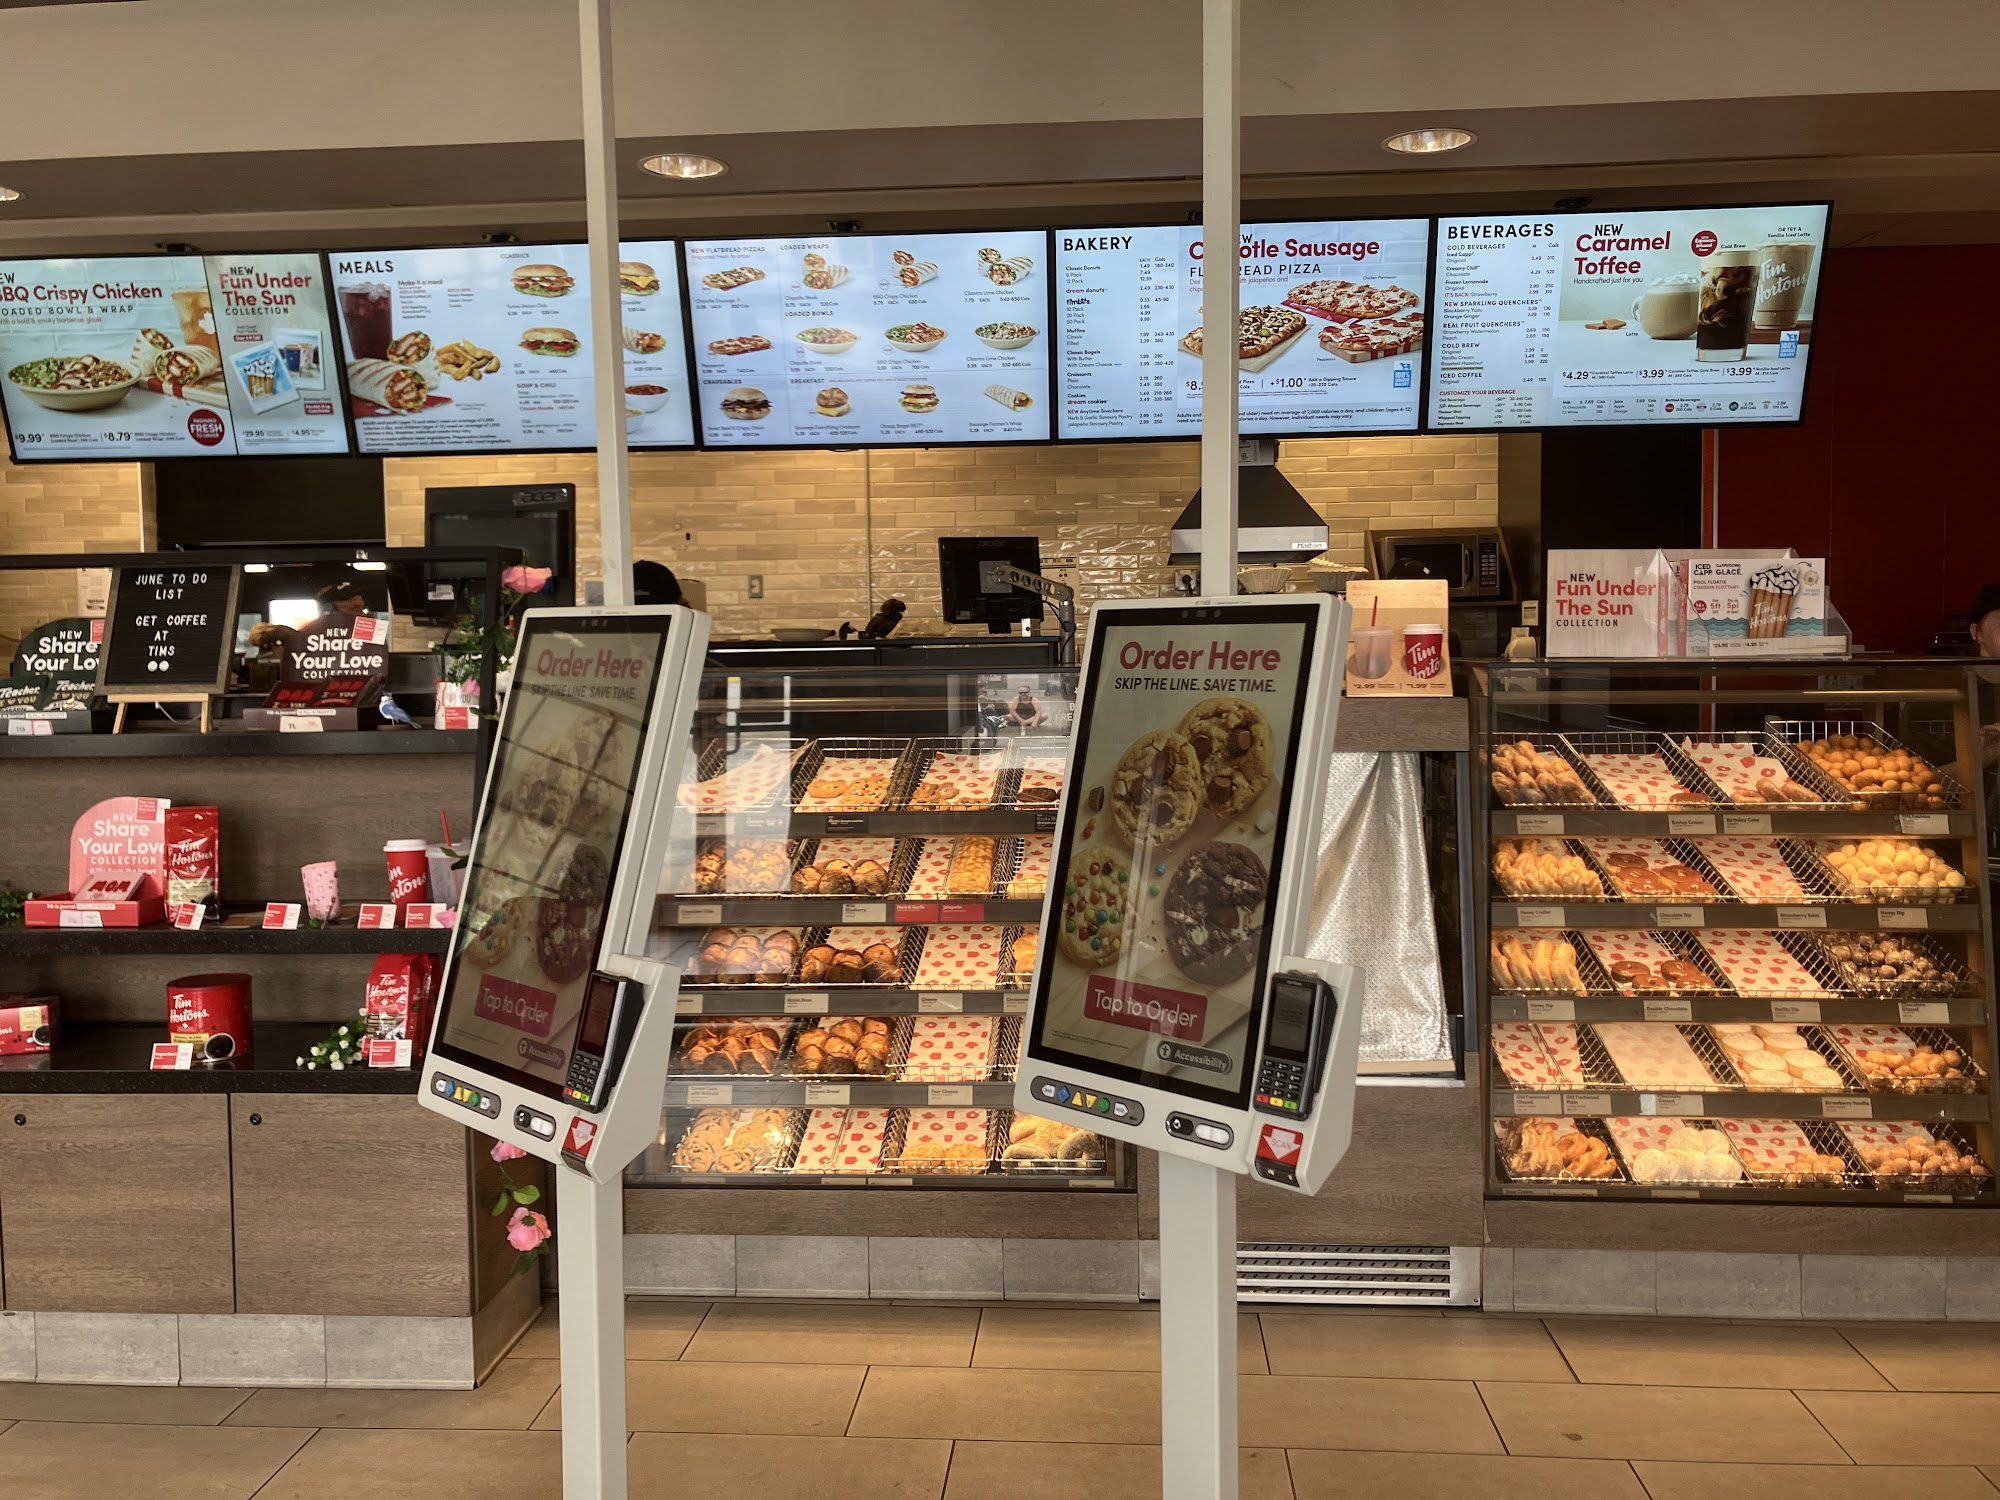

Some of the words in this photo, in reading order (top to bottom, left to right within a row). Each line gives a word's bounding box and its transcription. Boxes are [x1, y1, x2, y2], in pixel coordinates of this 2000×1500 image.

[1448, 224, 1554, 239] BEVERAGES
[1595, 224, 1623, 237] NEW
[1064, 236, 1132, 251] BAKERY
[1576, 231, 1671, 252] Caramel
[1189, 239, 1279, 260] Cotle
[1285, 238, 1380, 261] Sausage
[230, 266, 253, 275] NEW
[339, 260, 394, 274] MEALS
[1279, 264, 1321, 274] PIZZA
[1574, 256, 1641, 275] Toffee
[1760, 258, 1786, 282] Tim
[219, 274, 252, 289] Fun
[256, 272, 312, 288] Under
[1573, 277, 1610, 285] Handcrafted
[1611, 277, 1621, 285] just
[0, 286, 29, 303] BQ
[34, 285, 88, 304] Crispy
[93, 283, 162, 299] Chicken
[1757, 273, 1807, 306] Hortons
[222, 291, 256, 306] The
[261, 290, 296, 305] Sun
[1, 308, 42, 316] OADED
[49, 306, 81, 314] BOWL
[88, 306, 93, 314] &
[101, 305, 134, 313] WRAP
[225, 307, 289, 315] COLLECTION
[191, 424, 223, 433] FRESH
[135, 574, 164, 585] JUNE
[172, 573, 186, 584] TO
[192, 573, 208, 584] DO
[1570, 573, 1596, 582] NEW
[156, 589, 183, 600] LIST
[1557, 579, 1593, 596] Fun
[1596, 579, 1656, 596] Under
[1556, 599, 1591, 616] The
[1597, 599, 1633, 615] Sun
[135, 615, 158, 626] GET
[167, 614, 207, 626] COFFEE
[1556, 618, 1618, 627] COLLECTION
[59, 631, 82, 640] NEW
[154, 631, 168, 641] AT
[326, 628, 348, 636] NEW
[38, 637, 98, 654] Share
[307, 634, 363, 651] Share
[148, 645, 175, 657] TIMS
[1120, 640, 1203, 670] Order
[1208, 641, 1281, 671] Here
[1407, 642, 1436, 664] Tim
[22, 654, 68, 671] Your
[291, 652, 336, 669] Your
[340, 652, 383, 669] Love
[537, 650, 595, 678] Order
[596, 649, 643, 679] Here
[531, 684, 549, 696] SKIP
[552, 685, 567, 697] THE
[589, 686, 613, 698] SAVE
[1115, 677, 1144, 690] SKIP
[1143, 678, 1167, 690] THE
[1169, 678, 1200, 691] LINE.
[1203, 679, 1236, 692] SAVE
[1239, 679, 1276, 692] TIME.
[113, 814, 135, 822] NEW
[93, 820, 150, 837] Share
[79, 837, 123, 855] Your
[178, 838, 201, 853] Tim
[91, 856, 156, 865] COLLECTION
[172, 851, 213, 866] Hortons
[172, 994, 192, 1010] Tim
[482, 987, 501, 1012] Tap
[502, 994, 513, 1014] to
[515, 998, 549, 1025] Order
[1094, 989, 1124, 1016] Tap
[1126, 997, 1142, 1016] to
[1145, 1000, 1198, 1027] Order
[1174, 1048, 1228, 1070] Accessibility
[575, 1128, 590, 1140] SCAN
[1271, 1137, 1292, 1150] SCAN
